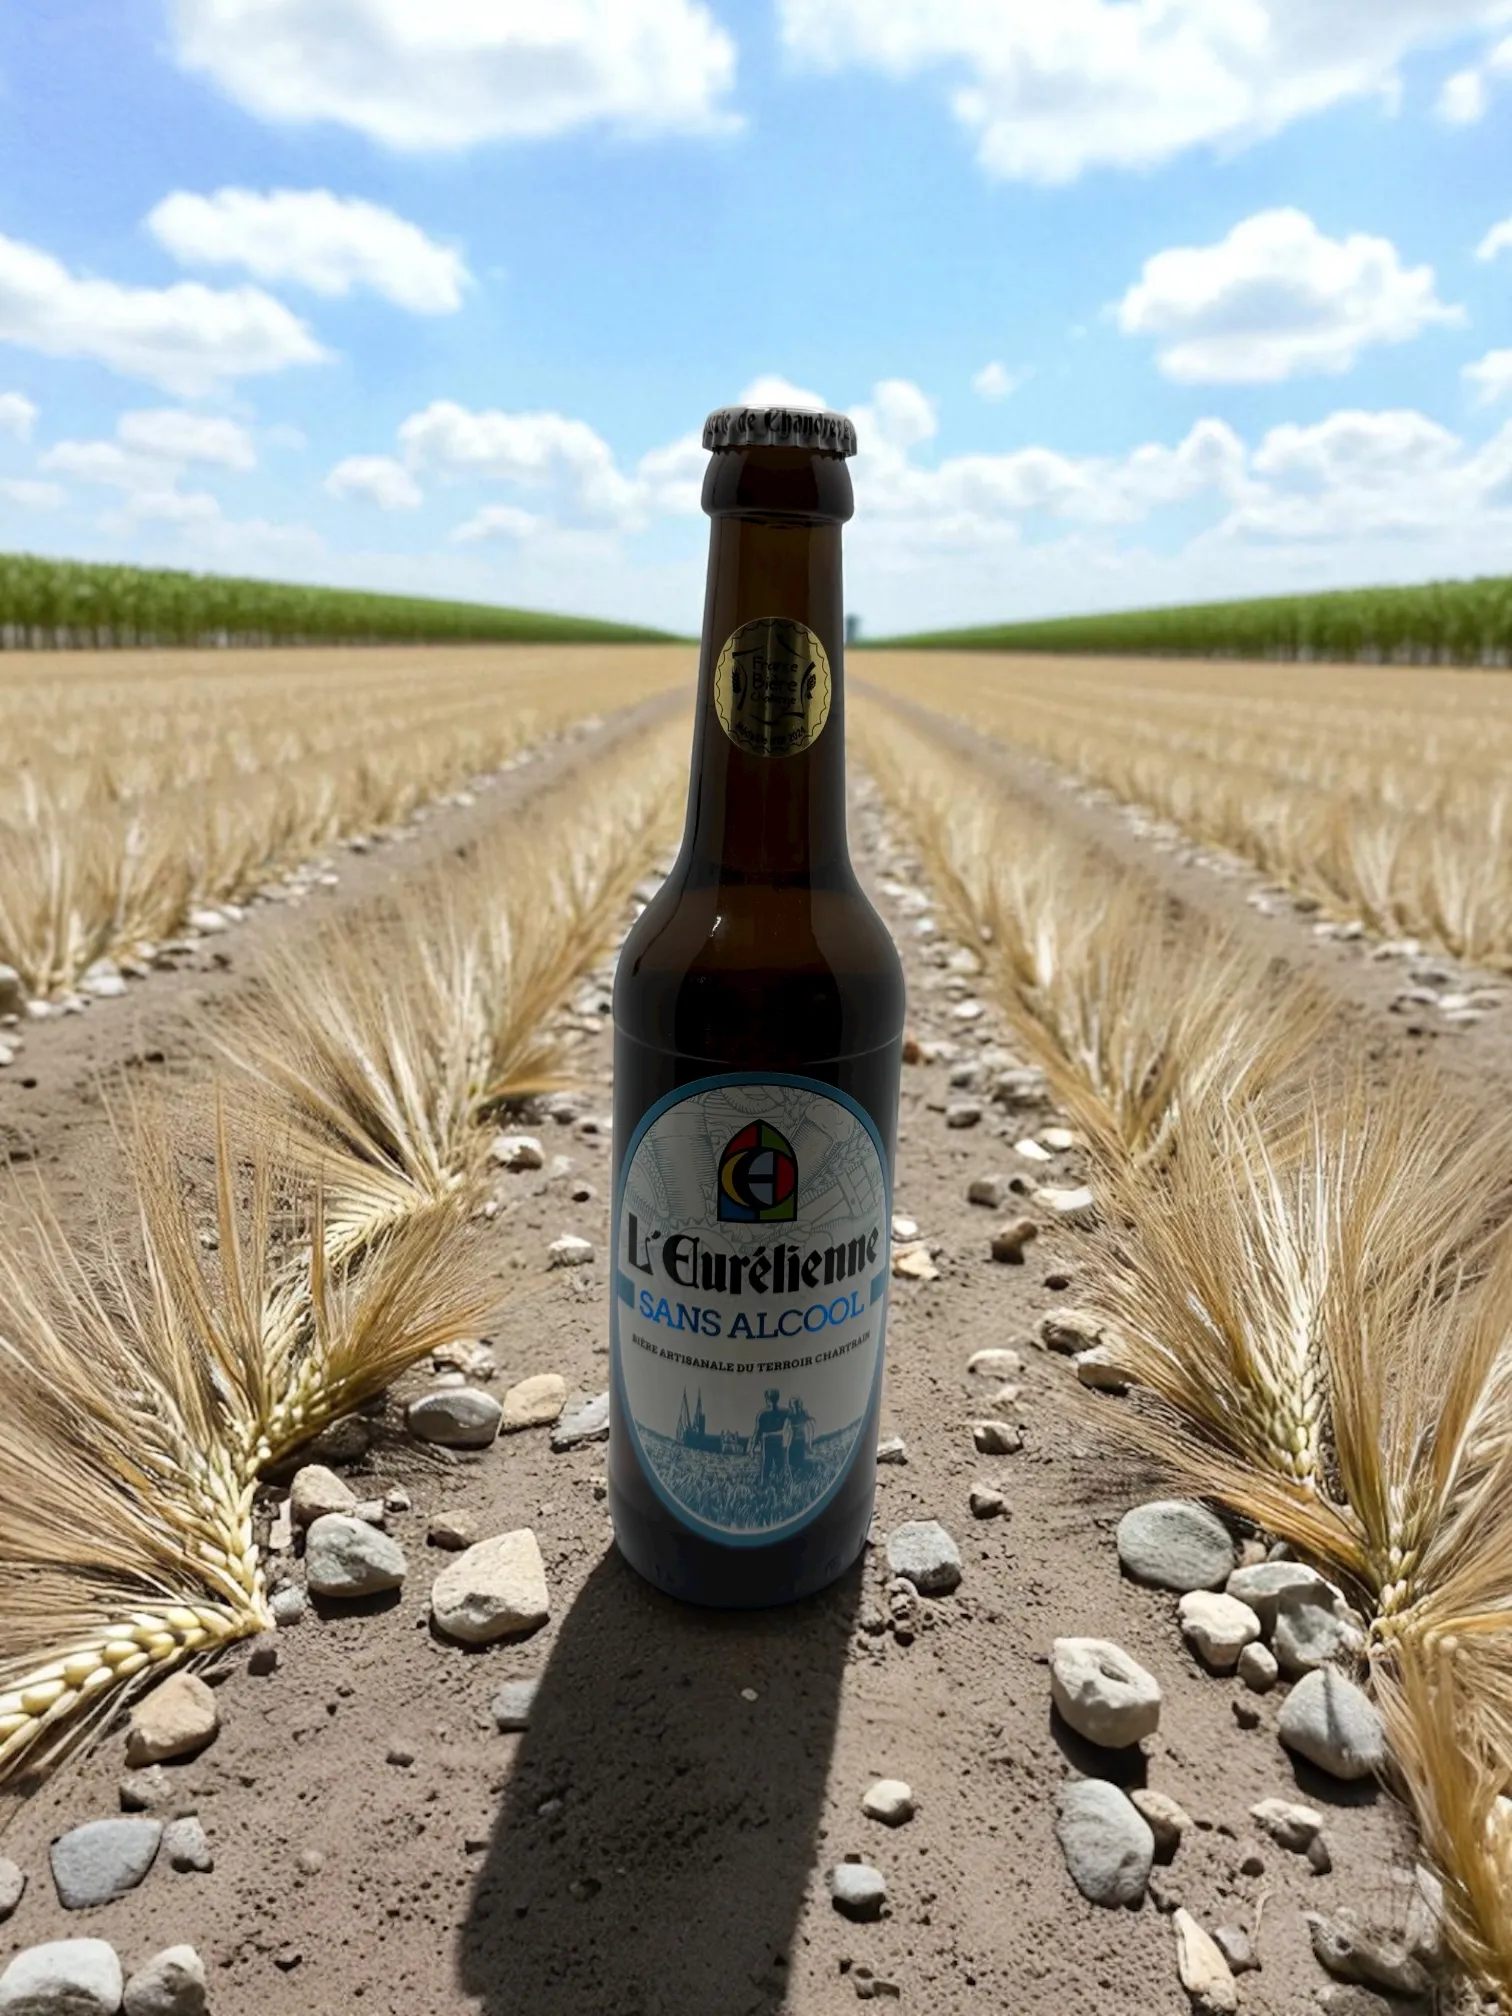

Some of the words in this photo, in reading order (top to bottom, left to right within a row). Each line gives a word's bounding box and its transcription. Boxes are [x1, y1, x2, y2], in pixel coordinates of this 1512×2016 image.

[737, 408, 756, 433] de
[628, 1211, 880, 1295] L'Eurélienne
[639, 1289, 722, 1337] SANS
[727, 1290, 865, 1340] ALCOOL
[632, 1333, 659, 1355] BIÈRE
[659, 1348, 735, 1373] ARTISANALE
[736, 1363, 754, 1374] DU
[757, 1356, 813, 1374] TERROIR
[815, 1329, 871, 1364] CHARTRAIN
